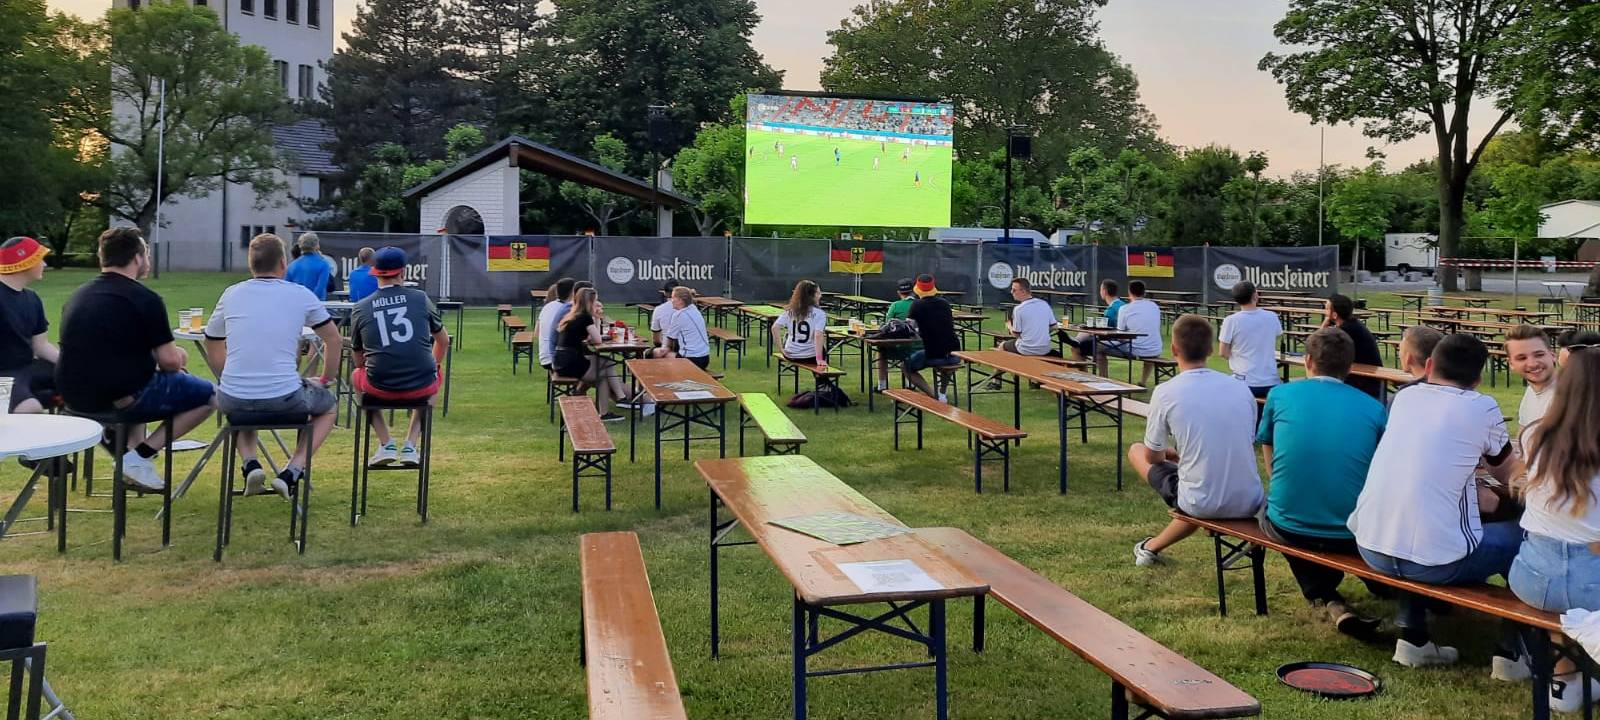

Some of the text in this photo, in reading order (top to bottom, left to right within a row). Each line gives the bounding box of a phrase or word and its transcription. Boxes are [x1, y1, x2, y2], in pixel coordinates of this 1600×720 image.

[637, 257, 715, 281] Warsteiner
[1017, 264, 1088, 290] Warsteiner
[1244, 264, 1330, 290] Warsteiner
[372, 294, 407, 309] MÜLLER
[373, 306, 414, 347] 13
[791, 319, 811, 344] 19
